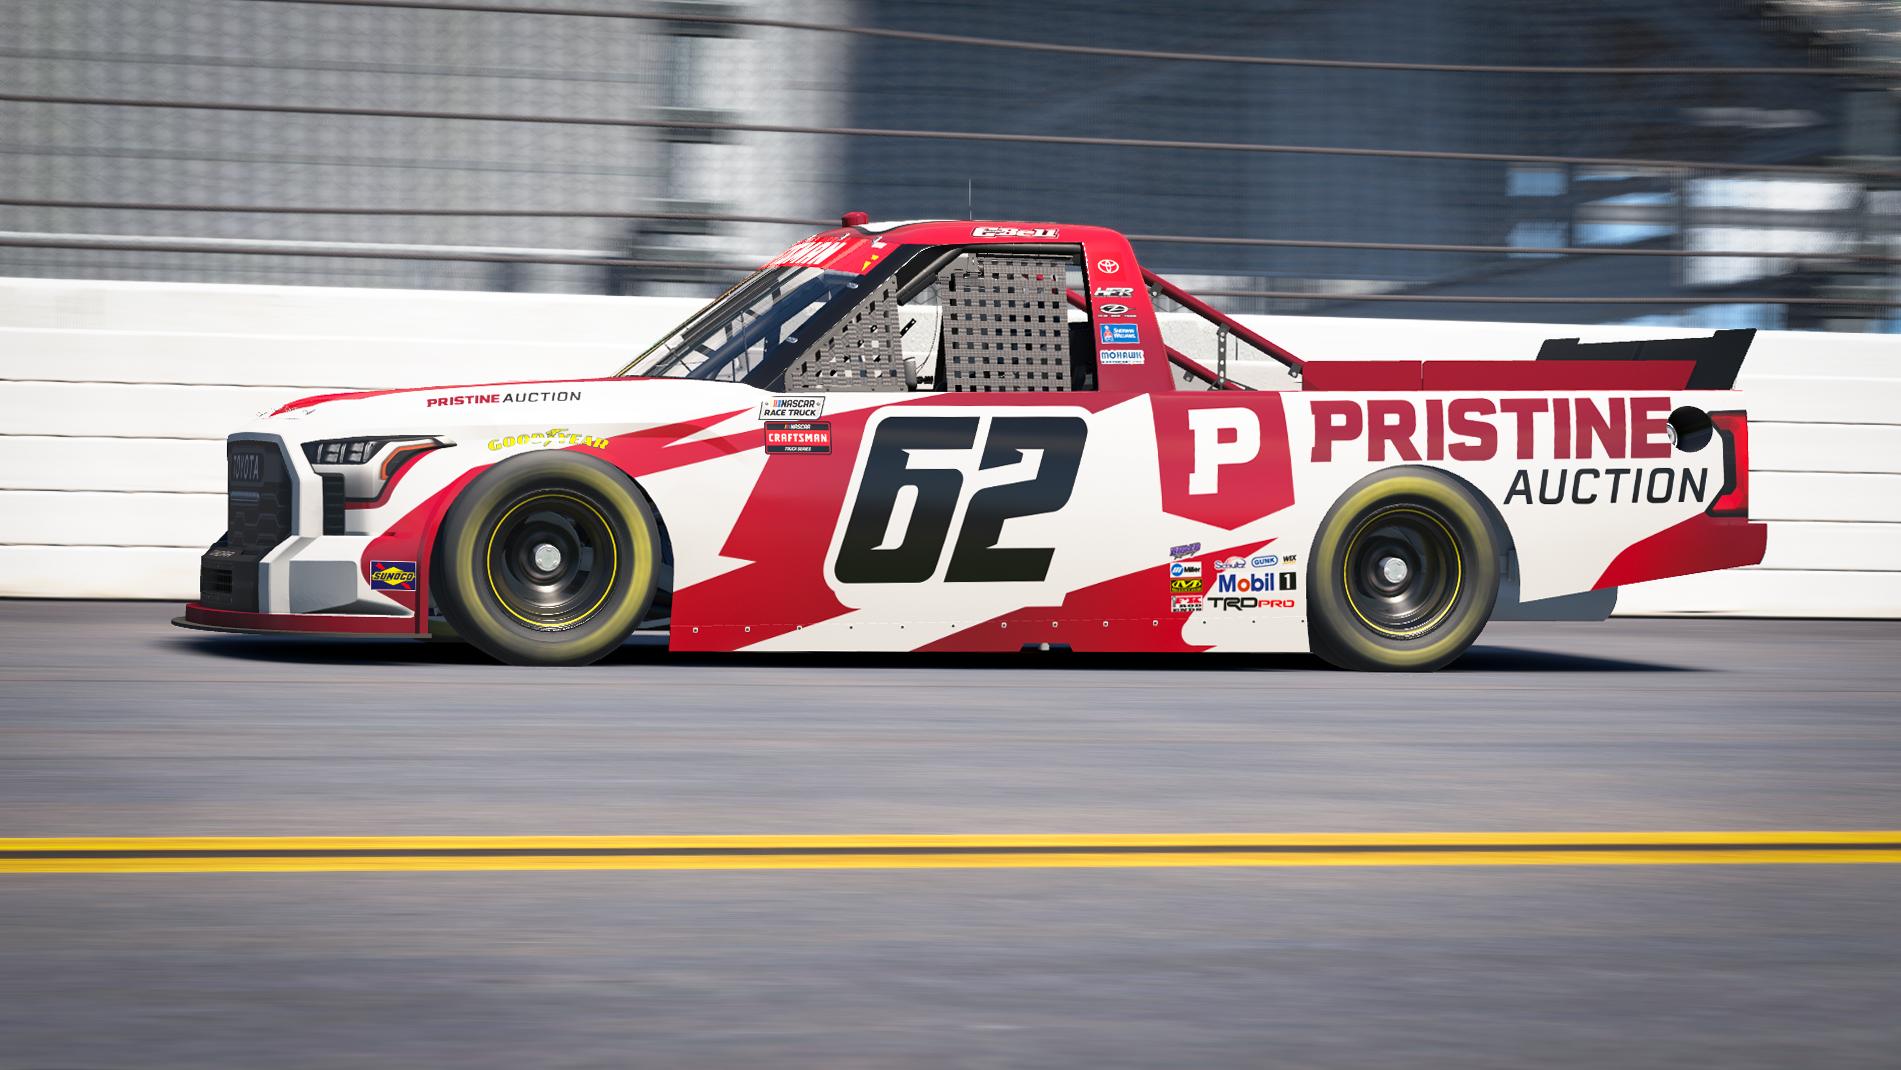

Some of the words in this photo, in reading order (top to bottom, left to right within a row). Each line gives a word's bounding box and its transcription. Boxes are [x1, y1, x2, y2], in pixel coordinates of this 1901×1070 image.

[1101, 351, 1142, 359] MOHAWK
[427, 394, 500, 407] PRISTINE
[502, 391, 581, 403] AUCTION
[781, 399, 815, 407] NASCAR
[768, 433, 828, 443] CRAFTSMAN
[1310, 397, 1671, 462] PRISTINE
[1188, 407, 1261, 495] P
[233, 455, 260, 480] TOYOTA
[1504, 468, 1709, 505] AUCTION
[834, 416, 1089, 583] 62
[1254, 557, 1275, 565] GUNK
[373, 572, 414, 580] SUNOCO
[1219, 573, 1274, 592] Mobil
